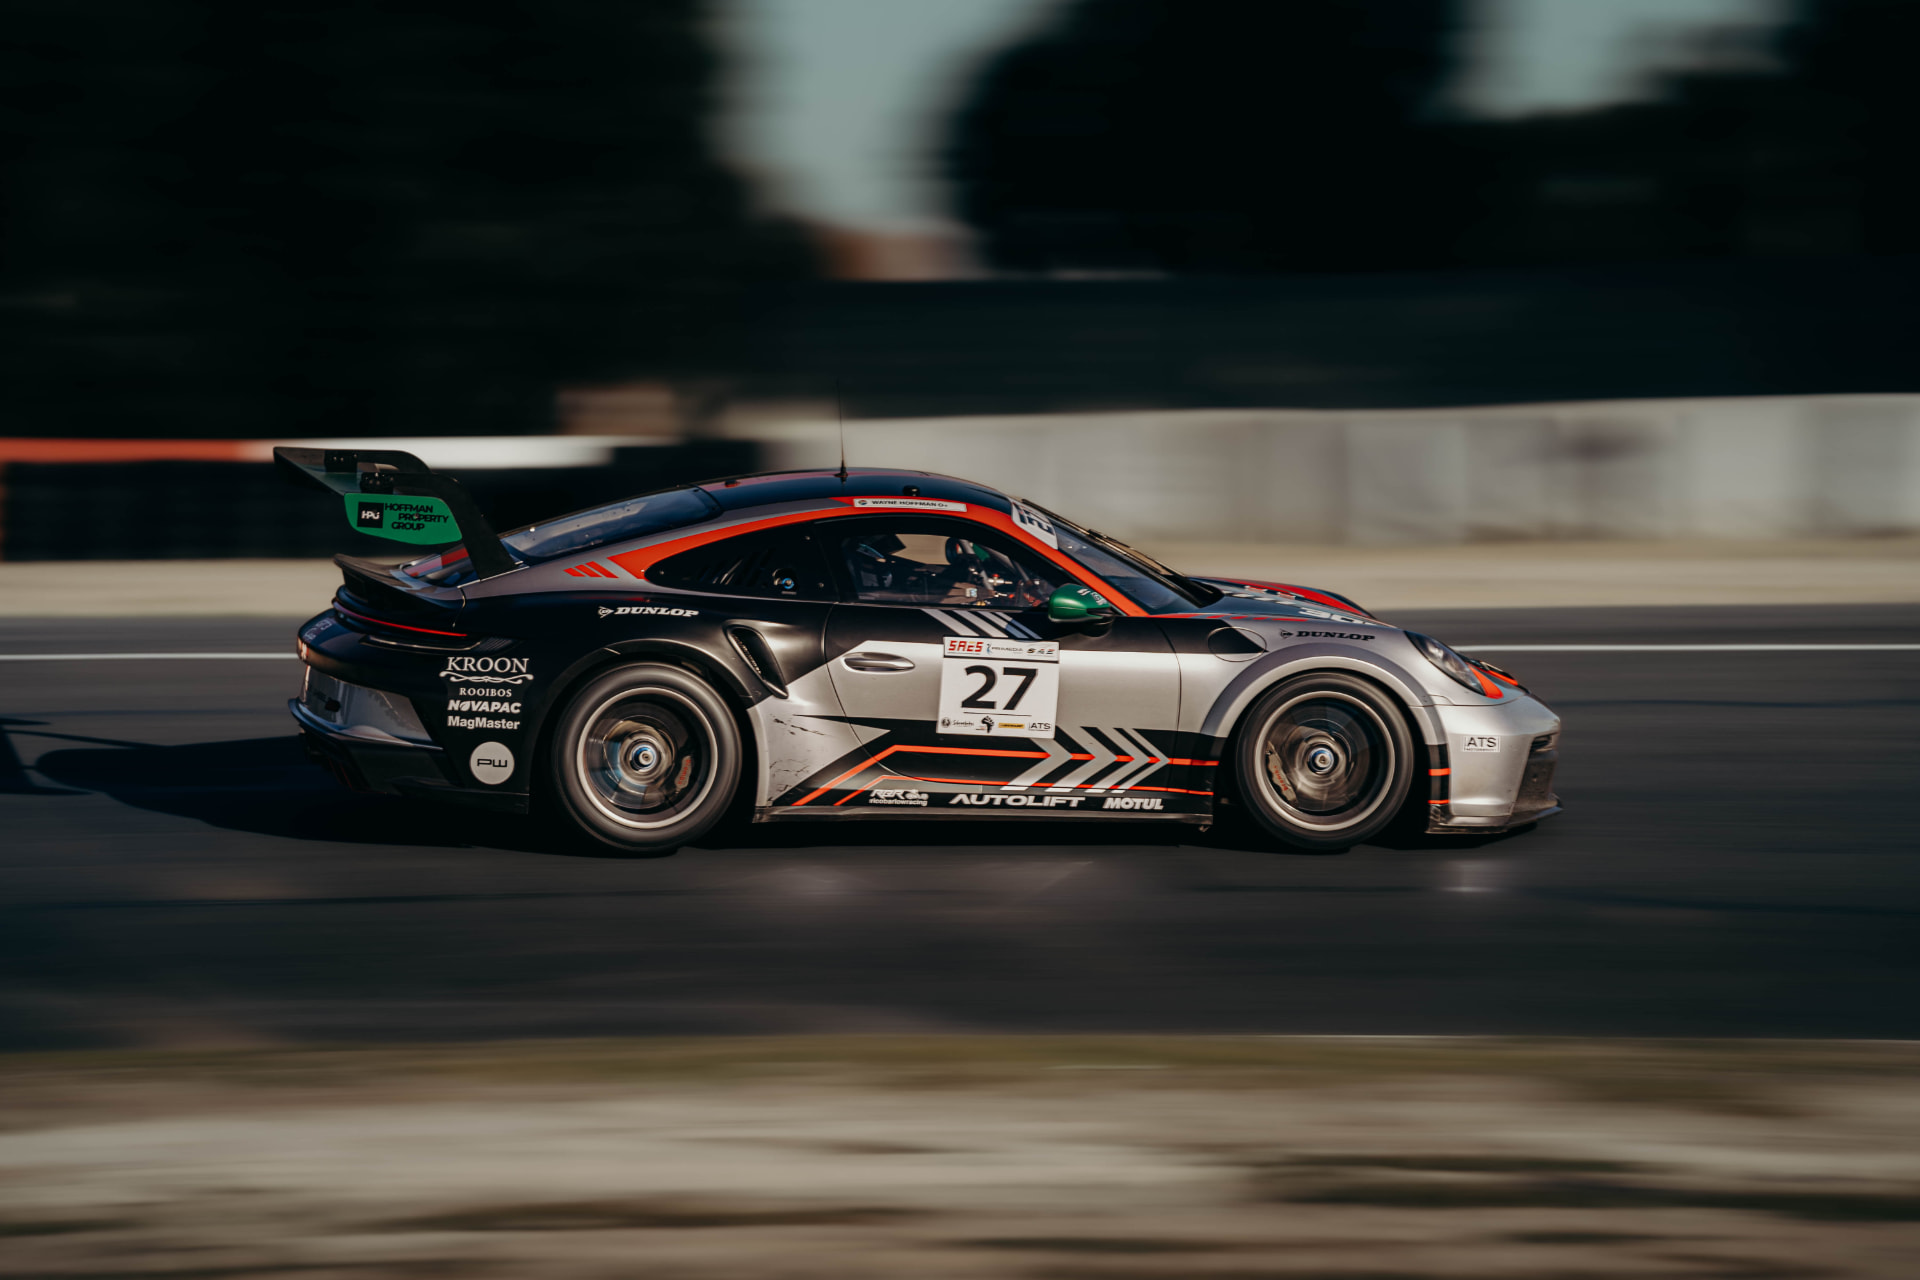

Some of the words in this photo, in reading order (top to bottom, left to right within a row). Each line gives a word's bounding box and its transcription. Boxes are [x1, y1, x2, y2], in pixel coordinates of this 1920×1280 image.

[384, 503, 433, 513] HOFFMAN
[399, 513, 449, 523] PROPERTY
[391, 521, 425, 530] GROUP
[614, 607, 699, 617] DUNLOP
[1296, 630, 1375, 641] DUNLOP
[445, 656, 530, 673] KROON
[459, 687, 512, 697] ROOIBOS
[961, 664, 1038, 710] 27
[447, 715, 520, 729] MagMaster
[1030, 722, 1052, 730] ATS
[1467, 736, 1497, 748] ATS
[948, 793, 1086, 808] AUTOLIFT
[1102, 797, 1164, 810] MOTUL
